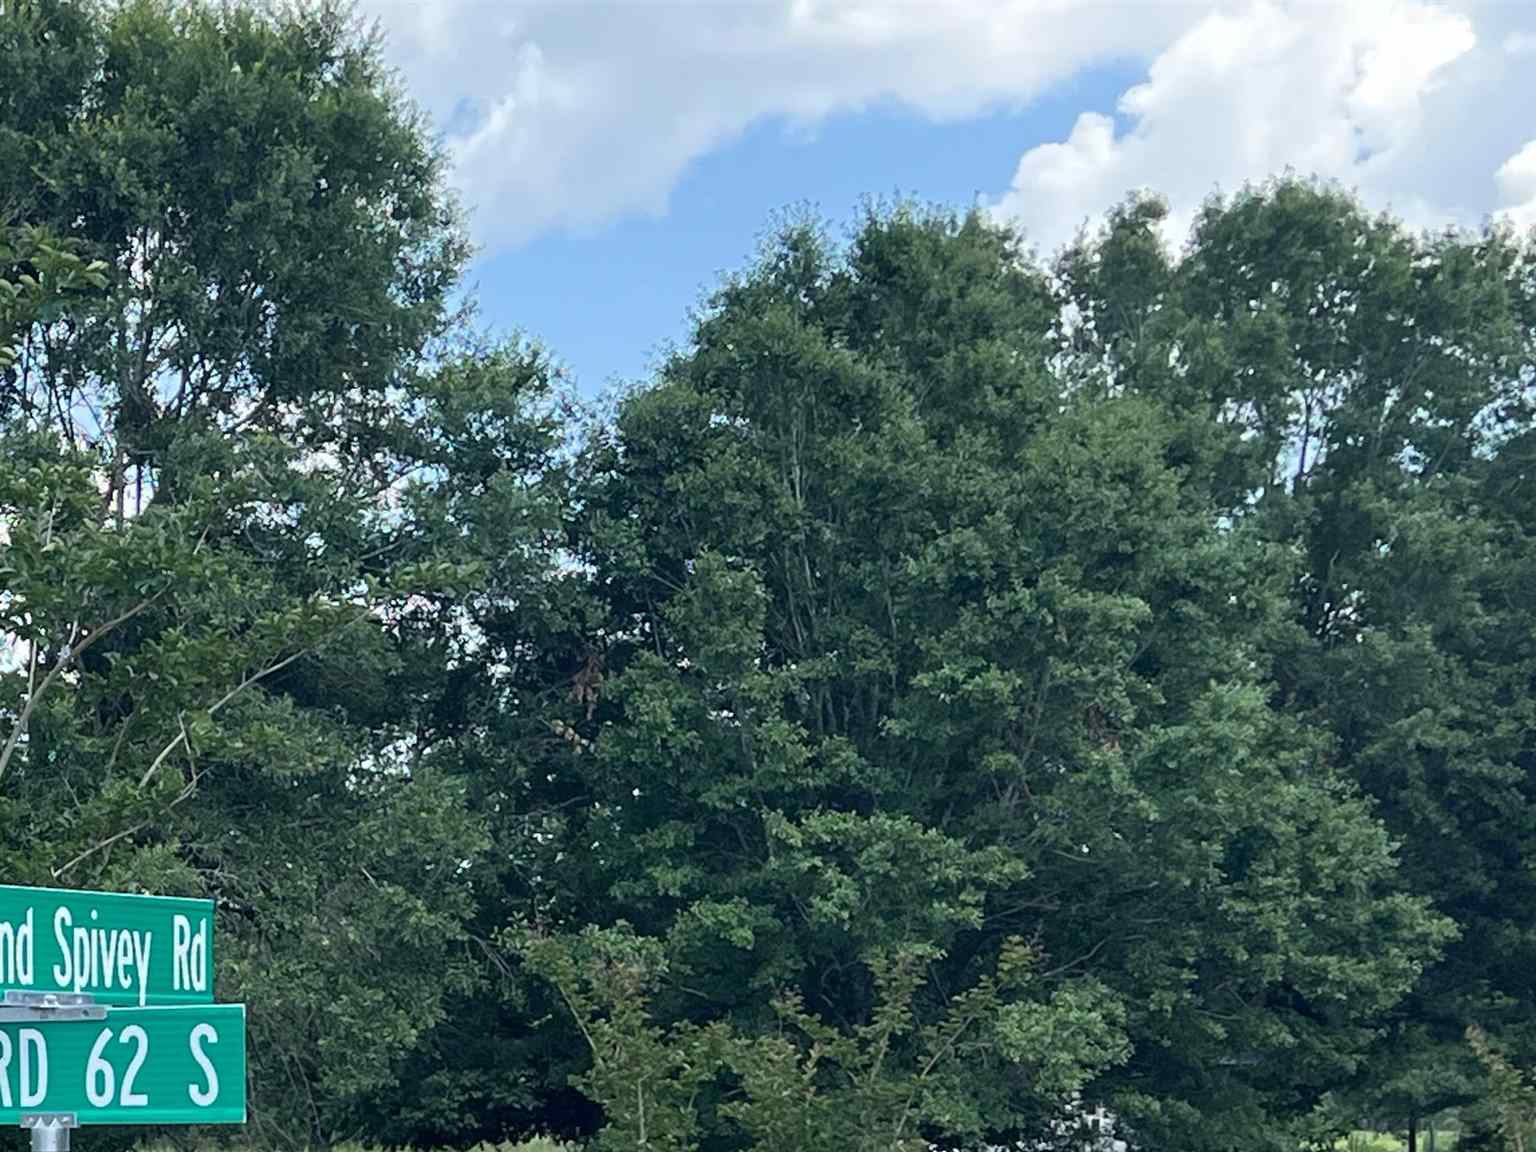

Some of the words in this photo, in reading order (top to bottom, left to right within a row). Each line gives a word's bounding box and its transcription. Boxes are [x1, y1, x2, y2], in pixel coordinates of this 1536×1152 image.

[54, 905, 152, 1007] Spivey
[173, 914, 207, 992] Rd
[86, 1025, 149, 1108] 62
[188, 1023, 219, 1107] S
